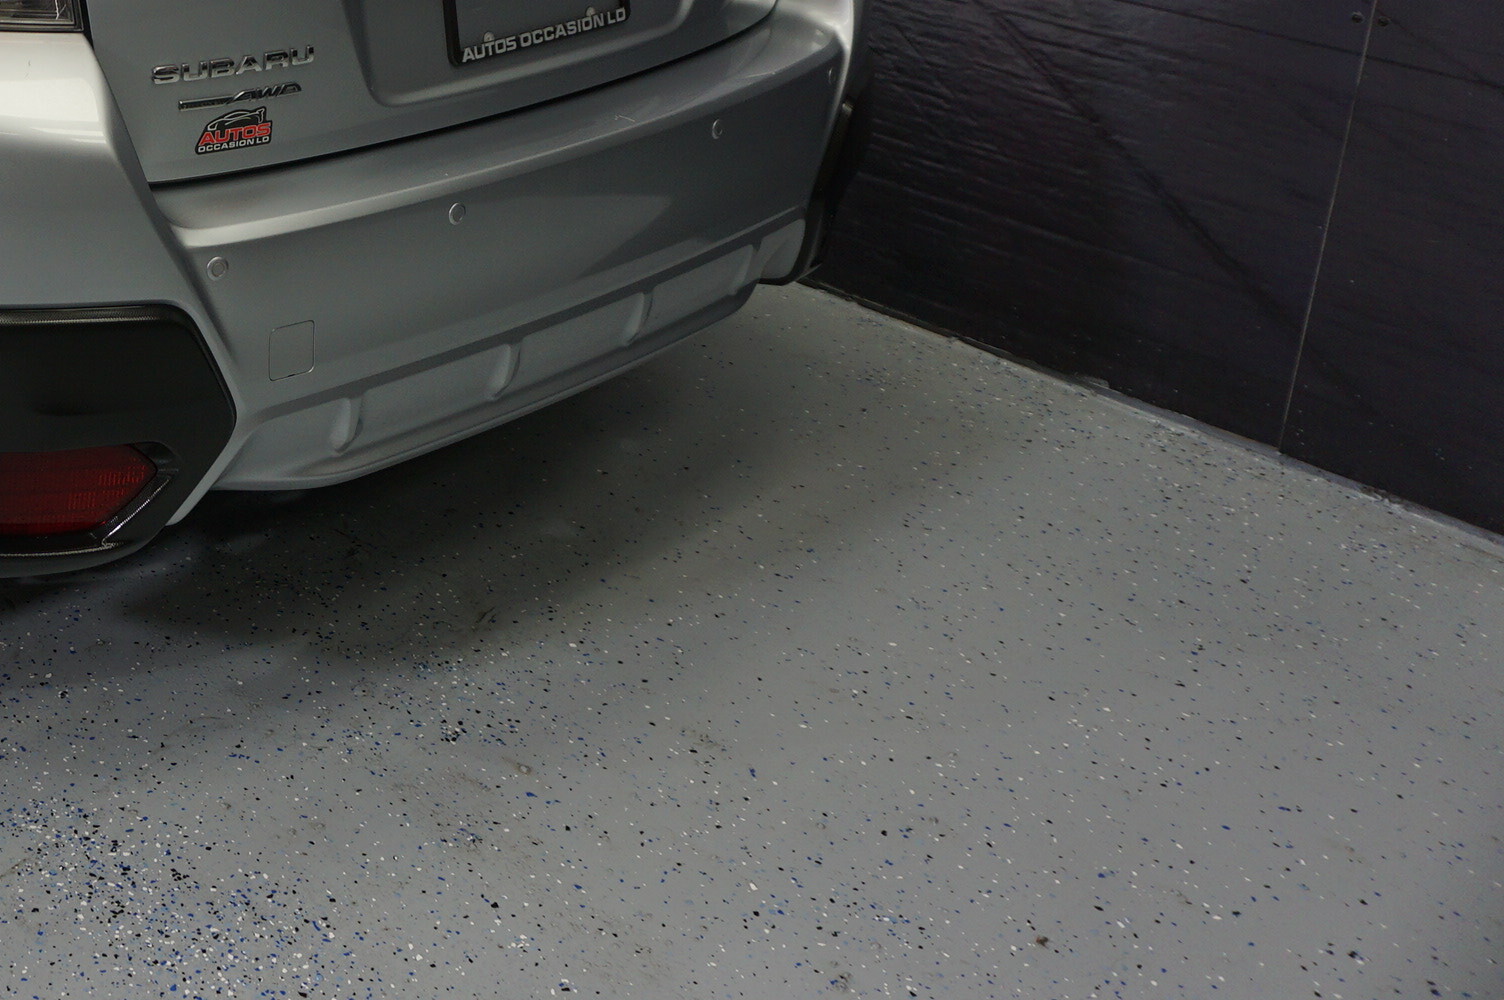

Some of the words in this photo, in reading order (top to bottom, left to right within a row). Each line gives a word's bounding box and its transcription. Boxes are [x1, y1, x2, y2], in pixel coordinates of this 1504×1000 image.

[462, 36, 516, 63] AUTOS
[520, 12, 604, 47] OCCASION
[608, 8, 627, 25] LD
[152, 45, 315, 85] SUBARU
[229, 82, 302, 104] AWD
[198, 138, 255, 154] OCCASION
[256, 136, 270, 146] LD
[199, 122, 271, 146] AUTOS
